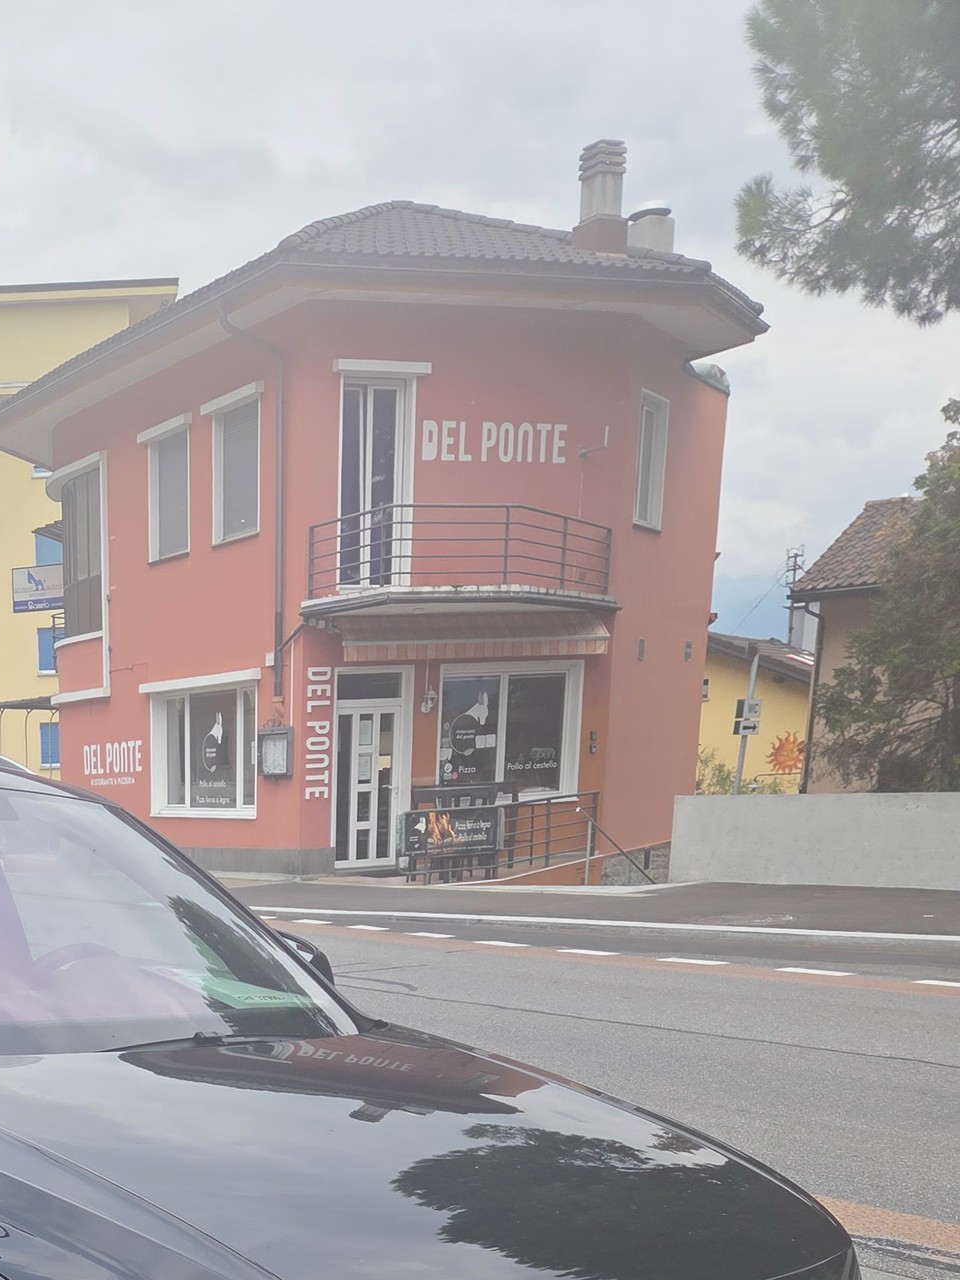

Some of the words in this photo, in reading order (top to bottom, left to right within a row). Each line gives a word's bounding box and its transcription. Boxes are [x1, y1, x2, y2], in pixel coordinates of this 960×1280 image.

[421, 420, 472, 461] DEL
[481, 422, 568, 464] PONTE
[306, 667, 332, 713] DEL
[83, 743, 104, 775] DEL
[106, 740, 143, 774] PONTE
[305, 721, 331, 800] PONTE
[459, 765, 477, 774] Pizza
[507, 762, 524, 770] Pollo
[533, 760, 558, 769] cestello
[90, 778, 114, 786] RISTORANTE
[118, 777, 136, 785] PIZZERIA
